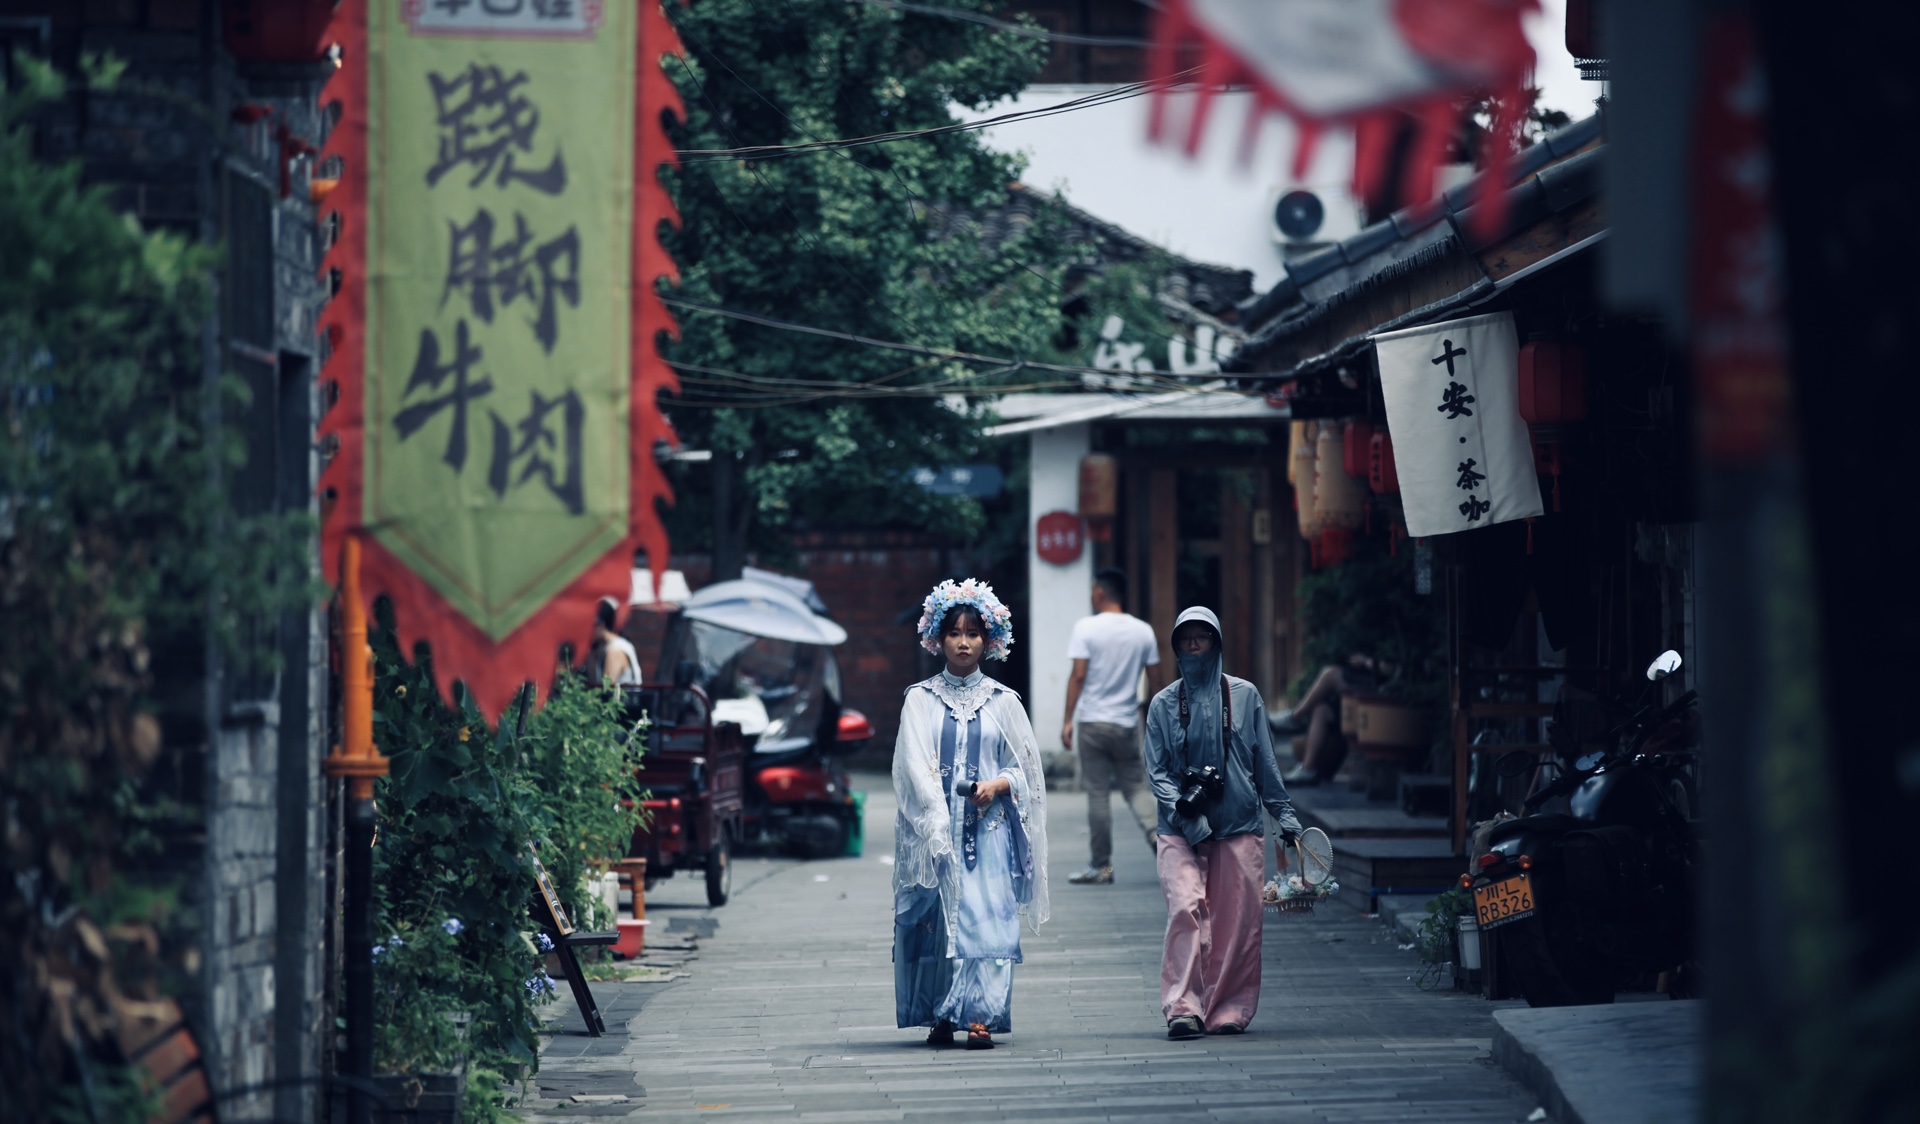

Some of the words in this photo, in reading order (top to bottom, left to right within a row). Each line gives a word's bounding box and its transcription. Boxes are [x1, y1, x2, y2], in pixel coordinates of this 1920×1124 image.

[392, 62, 586, 517] 跷脚牛肉
[1480, 892, 1531, 923] RB326
